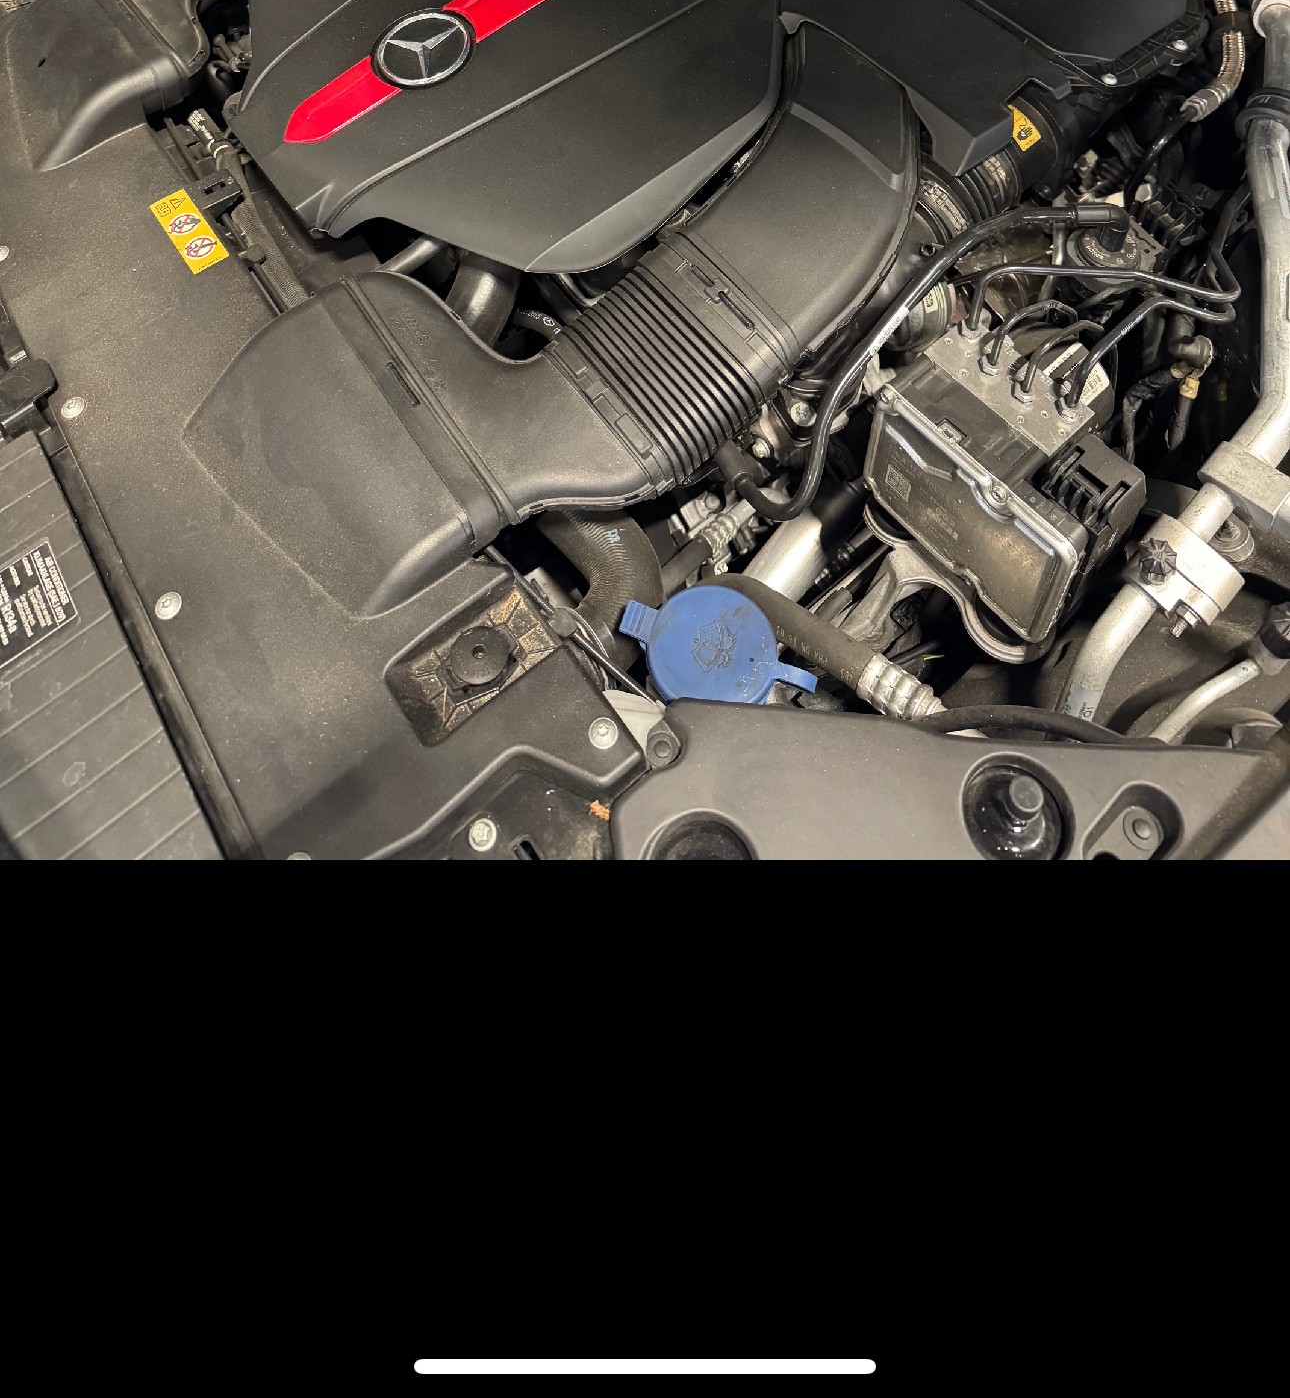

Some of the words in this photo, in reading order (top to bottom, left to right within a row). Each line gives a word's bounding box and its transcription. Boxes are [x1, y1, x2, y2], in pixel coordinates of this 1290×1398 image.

[33, 550, 54, 590] KLIMAANLAGE
[44, 556, 54, 566] AIR
[49, 566, 69, 606] CONDITIONER
[1, 603, 17, 634] R134a
